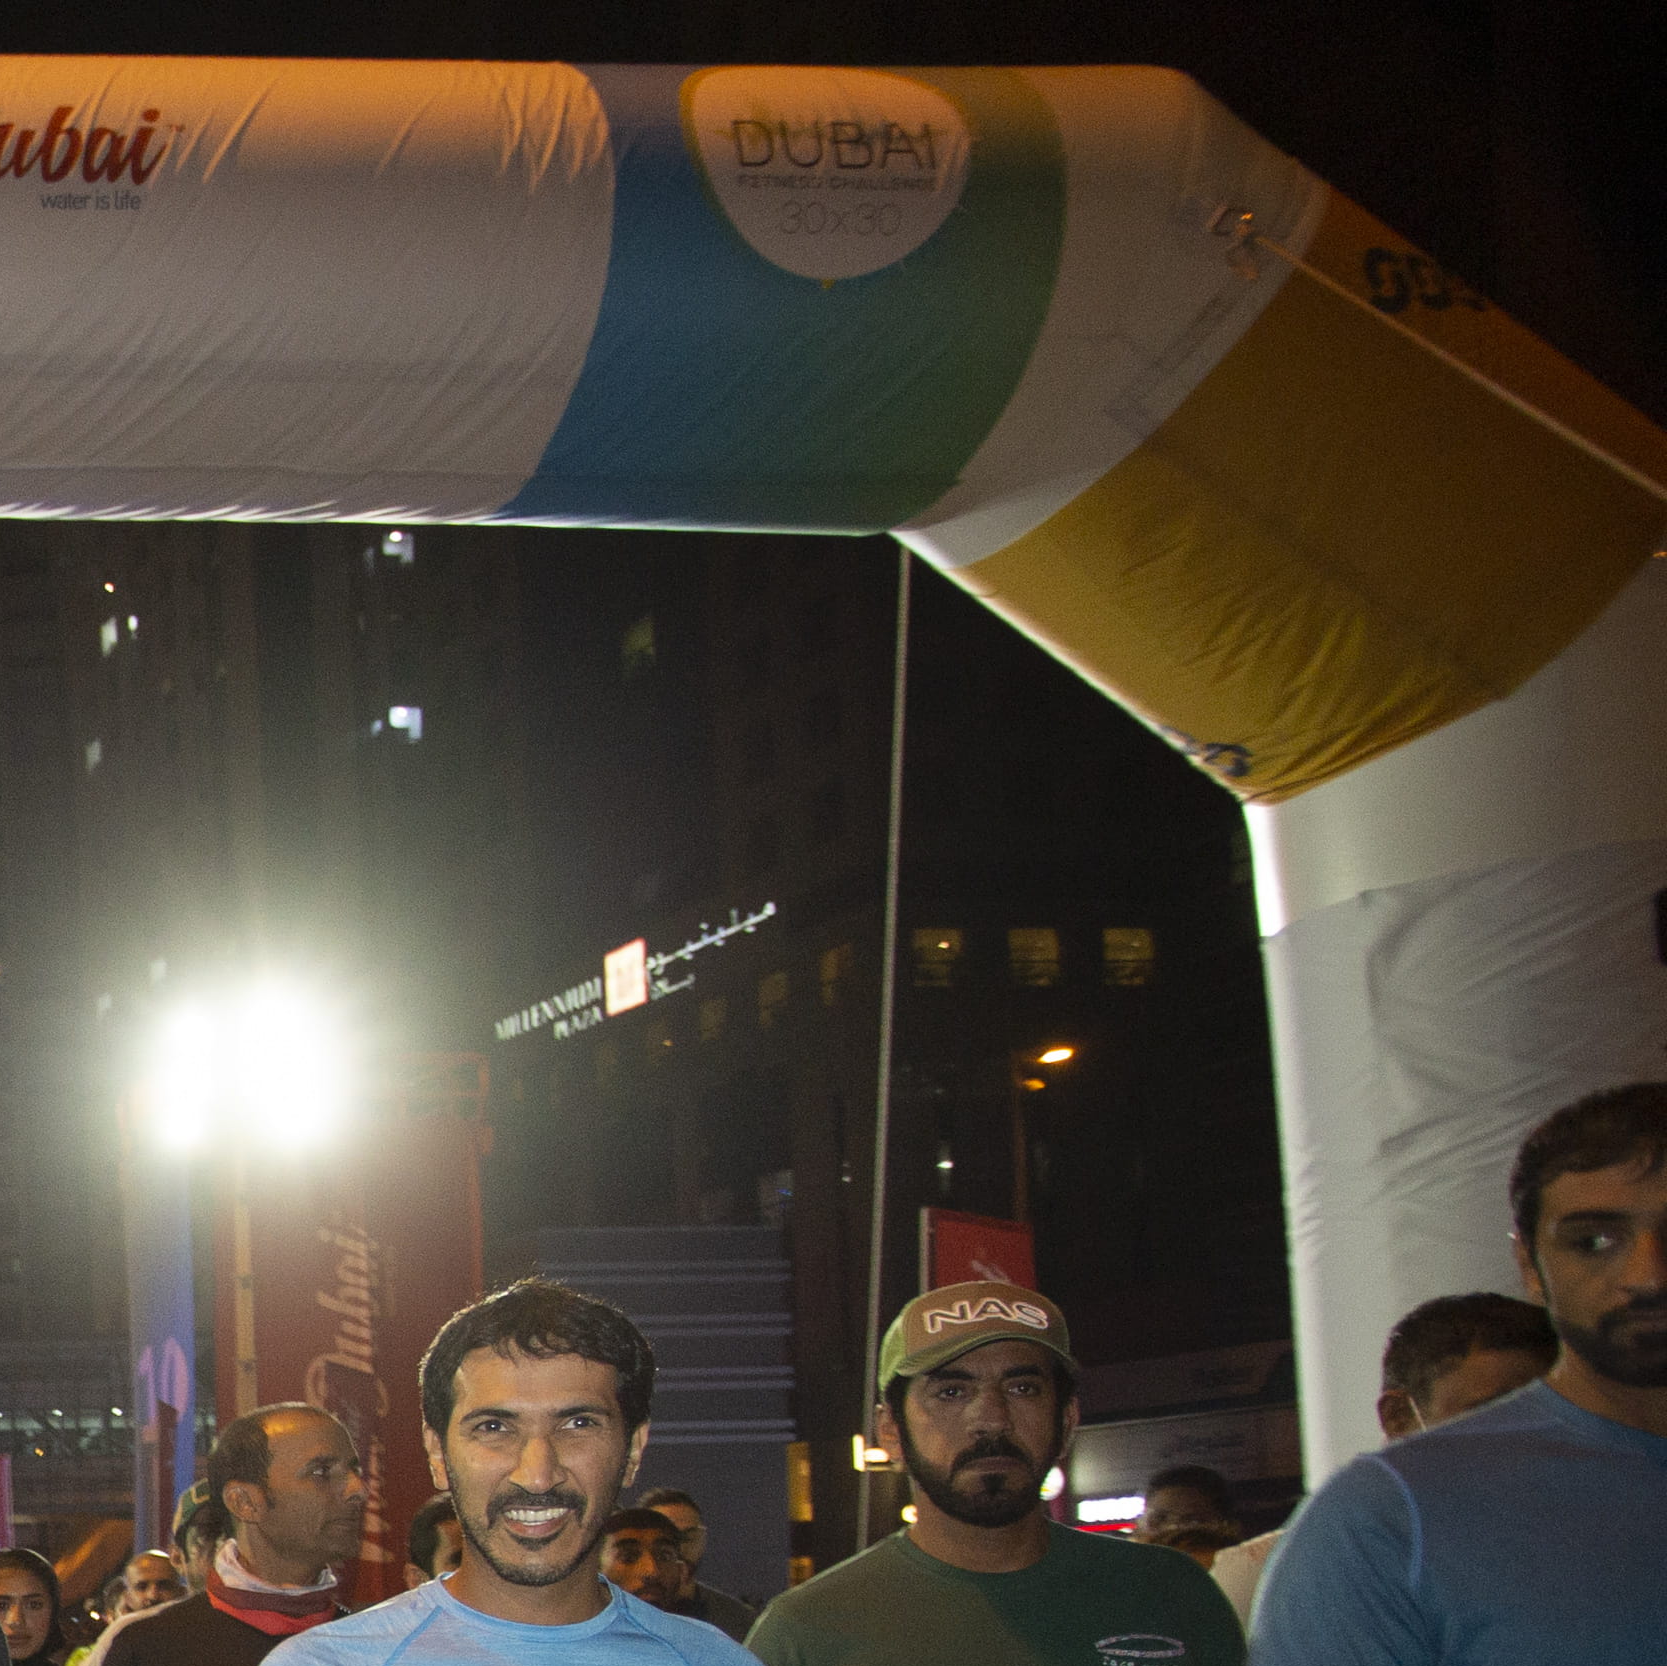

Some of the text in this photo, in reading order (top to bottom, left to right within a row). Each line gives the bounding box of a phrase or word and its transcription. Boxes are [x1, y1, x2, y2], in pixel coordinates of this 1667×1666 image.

[730, 119, 938, 170] DUBAI
[41, 191, 142, 210] water is life
[778, 200, 903, 237] 30x30
[922, 1297, 1049, 1334] NAS
